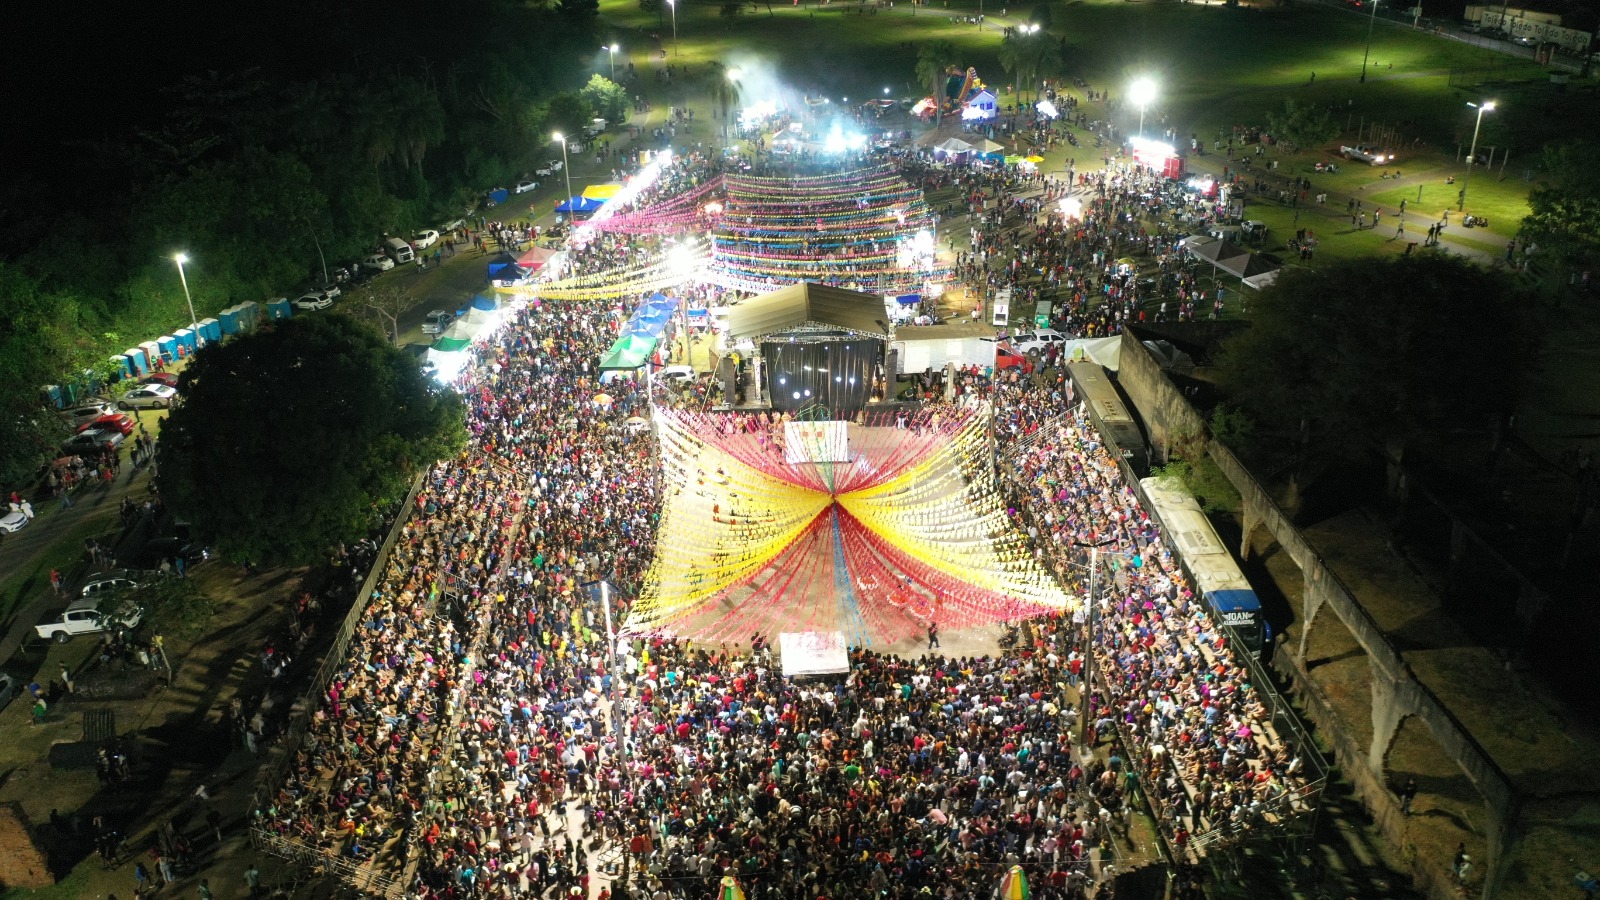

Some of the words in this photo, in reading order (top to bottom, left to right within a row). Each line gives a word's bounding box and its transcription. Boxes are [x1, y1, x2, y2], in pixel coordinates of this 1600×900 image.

[1484, 13, 1507, 26] Toledo
[1511, 19, 1532, 32] oledo
[1534, 24, 1559, 38] Toledo
[1562, 31, 1588, 44] Toledo
[1228, 612, 1249, 621] JOAN
